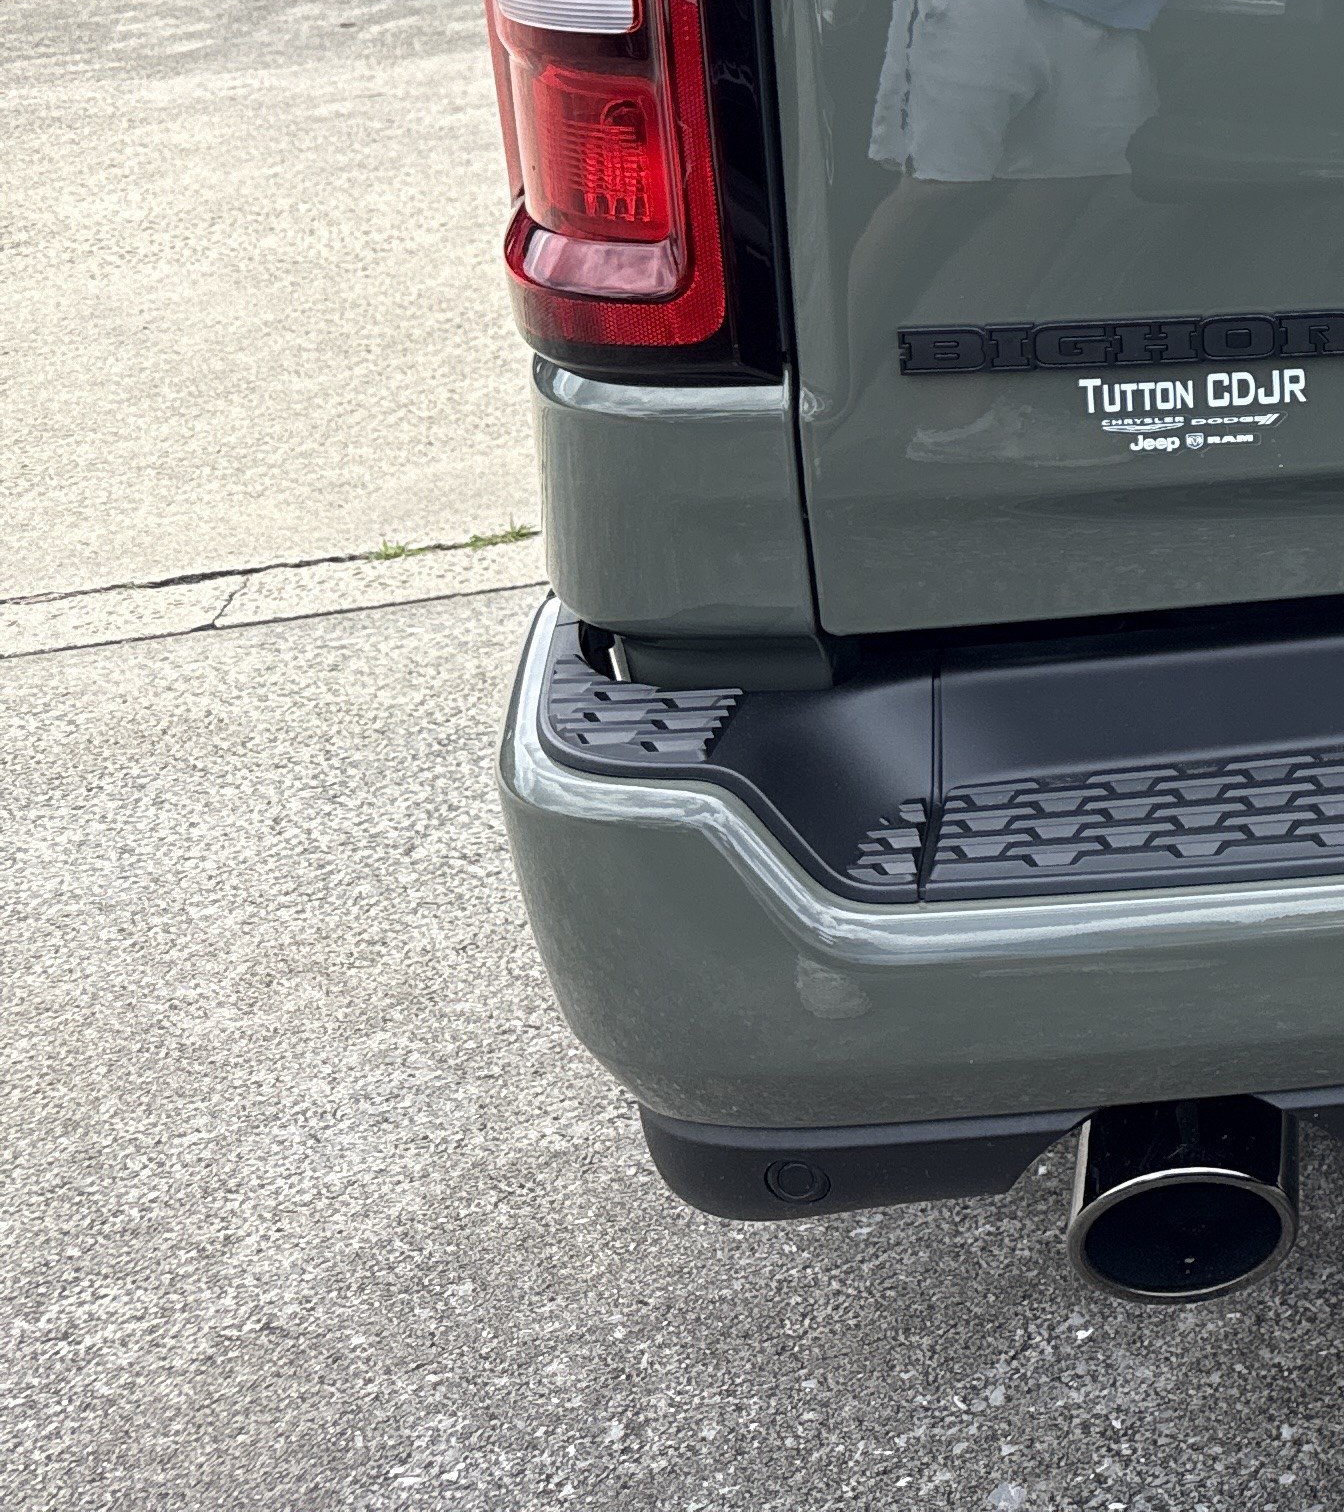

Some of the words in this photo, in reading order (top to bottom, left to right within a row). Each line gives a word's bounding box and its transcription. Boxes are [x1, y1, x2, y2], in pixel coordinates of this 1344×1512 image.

[1207, 368, 1307, 408] CDJR
[1101, 416, 1185, 426] CHRYSLER
[1129, 435, 1180, 452] Jeep
[1207, 434, 1254, 444] RAM
